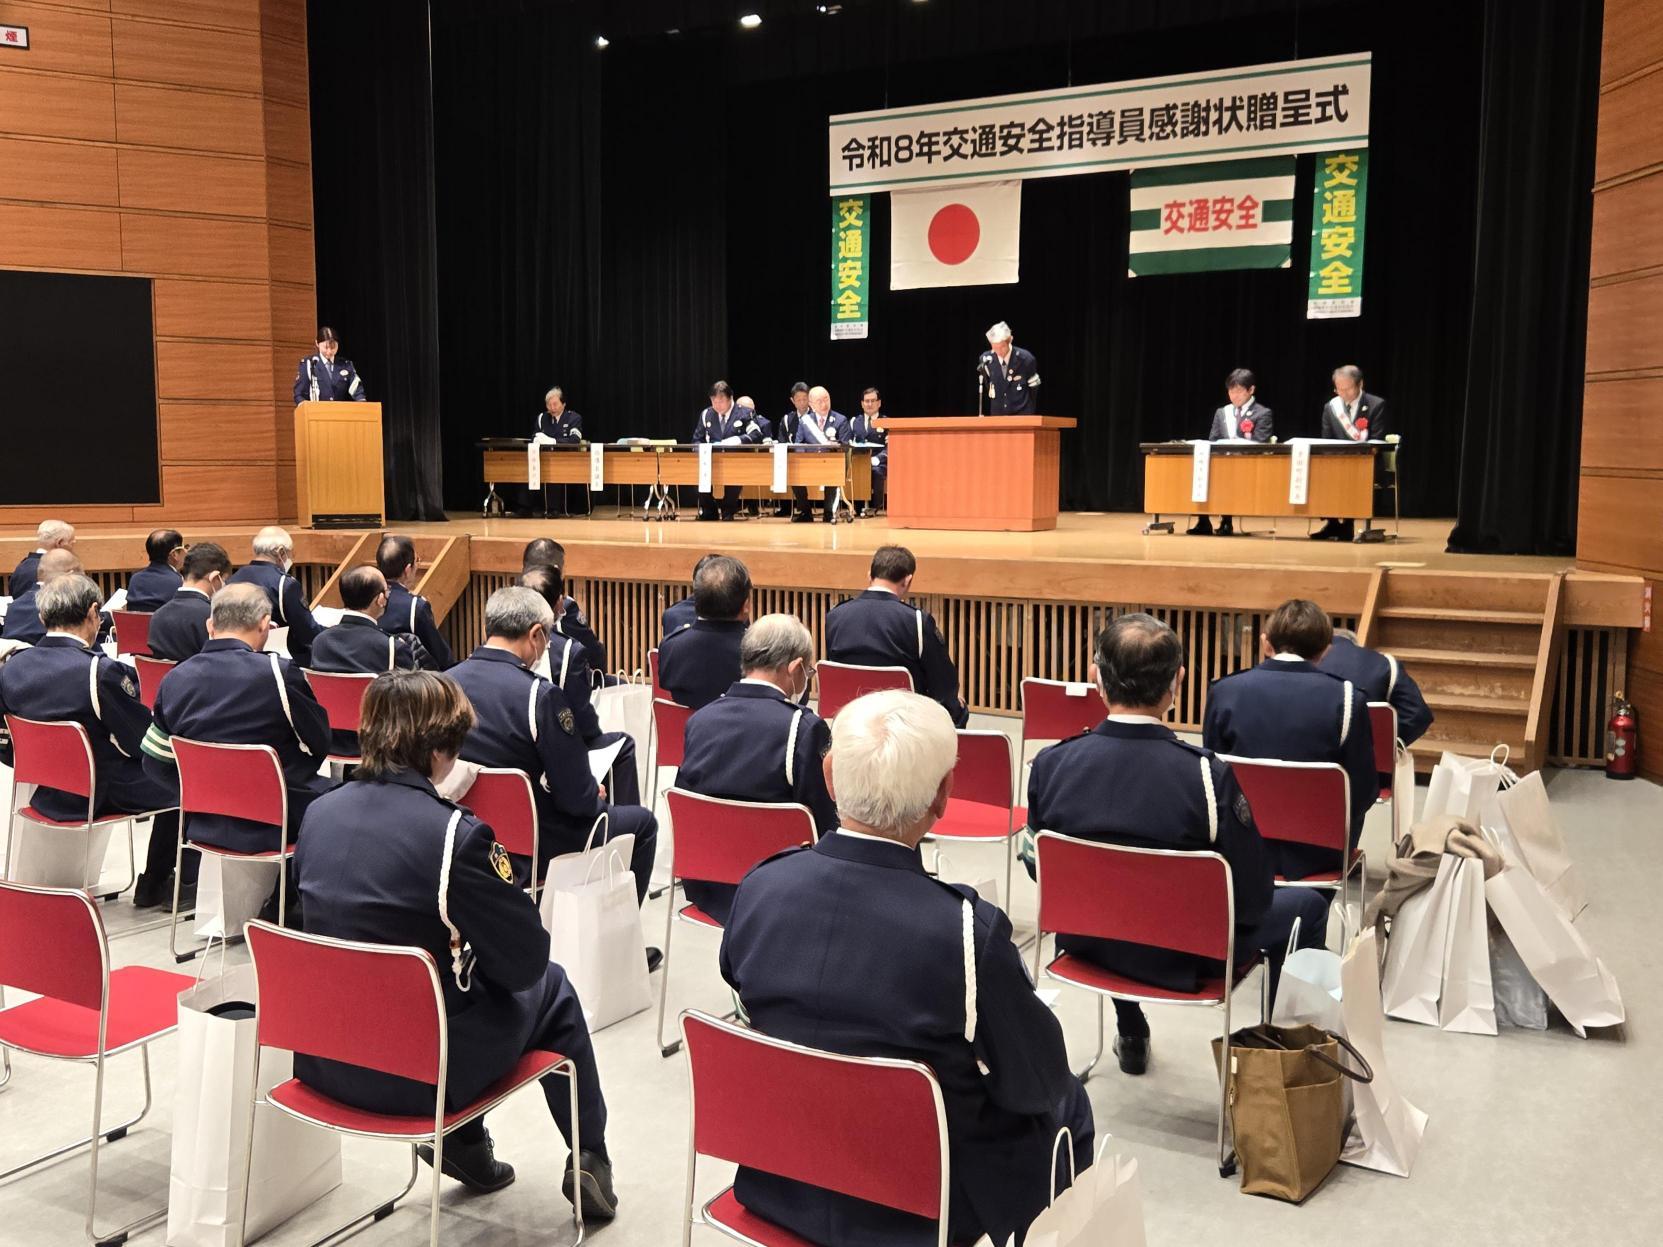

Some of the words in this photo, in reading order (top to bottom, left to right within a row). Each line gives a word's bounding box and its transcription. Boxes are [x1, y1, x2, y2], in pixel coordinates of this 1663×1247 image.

[841, 84, 1349, 172] 令和8年交通安全指導員感謝状贈呈式
[837, 199, 863, 319] 交通安全
[1163, 194, 1260, 235] 交通安全
[1318, 154, 1359, 295] 交通安全
